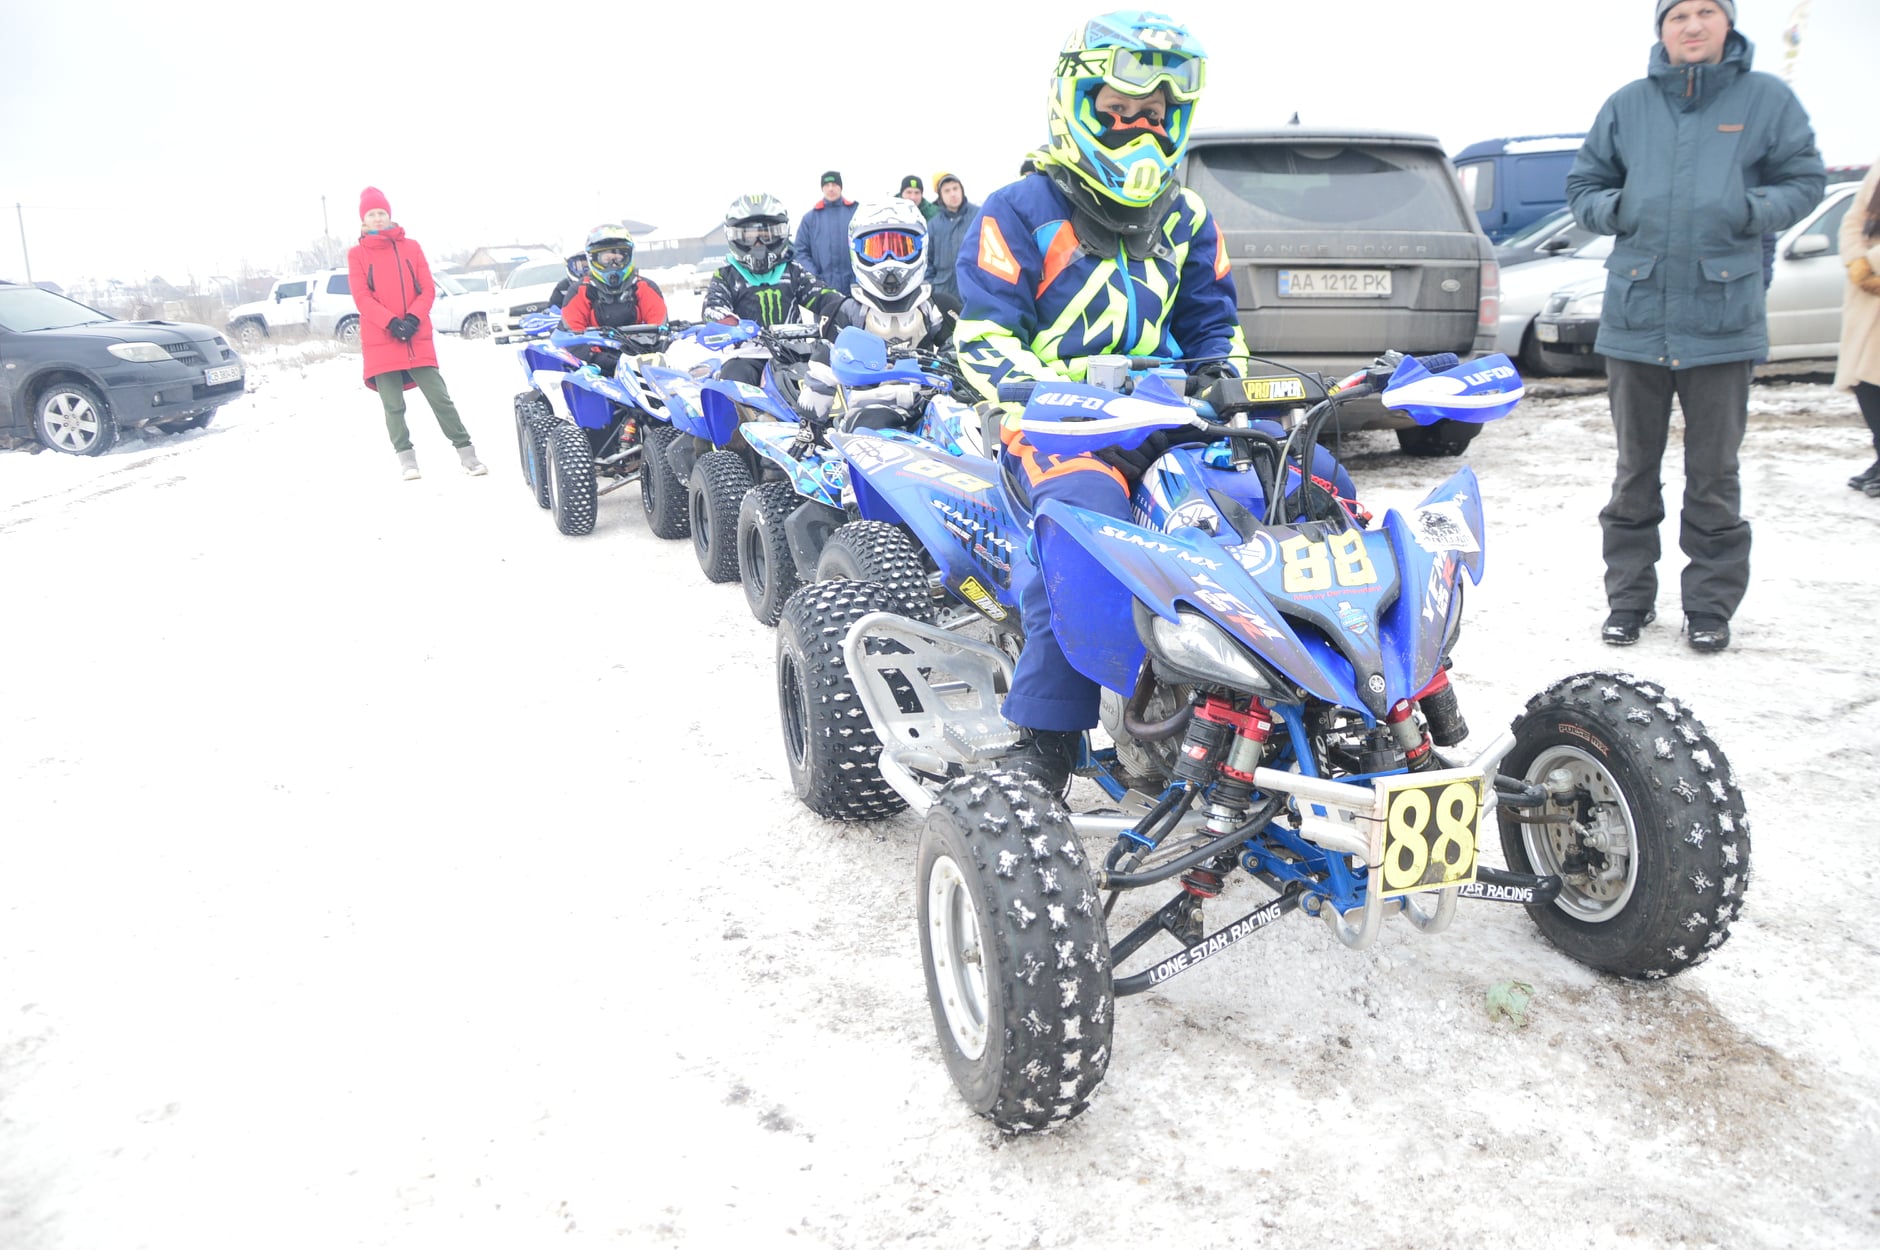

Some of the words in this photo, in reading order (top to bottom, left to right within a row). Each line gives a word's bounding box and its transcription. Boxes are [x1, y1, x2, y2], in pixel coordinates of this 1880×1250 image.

[1244, 244, 1329, 253] RANGE
[1346, 245, 1427, 253] ROVER
[1290, 274, 1315, 291] AA
[1321, 274, 1359, 291] 1212
[1363, 274, 1388, 291] PK
[1463, 367, 1508, 386] UFO
[1049, 393, 1105, 411] UFO
[902, 459, 994, 493] 88
[930, 499, 986, 531] SUMY
[984, 532, 1019, 553] MX
[1099, 525, 1177, 553] SUMY
[1176, 551, 1223, 571] MX
[1279, 527, 1378, 593] 88
[1191, 571, 1287, 641] YFM
[1383, 781, 1478, 889] 88
[1486, 885, 1533, 901] RACING
[1149, 953, 1188, 985] LONE
[1190, 932, 1229, 964] STAR
[1230, 902, 1281, 942] RACING
